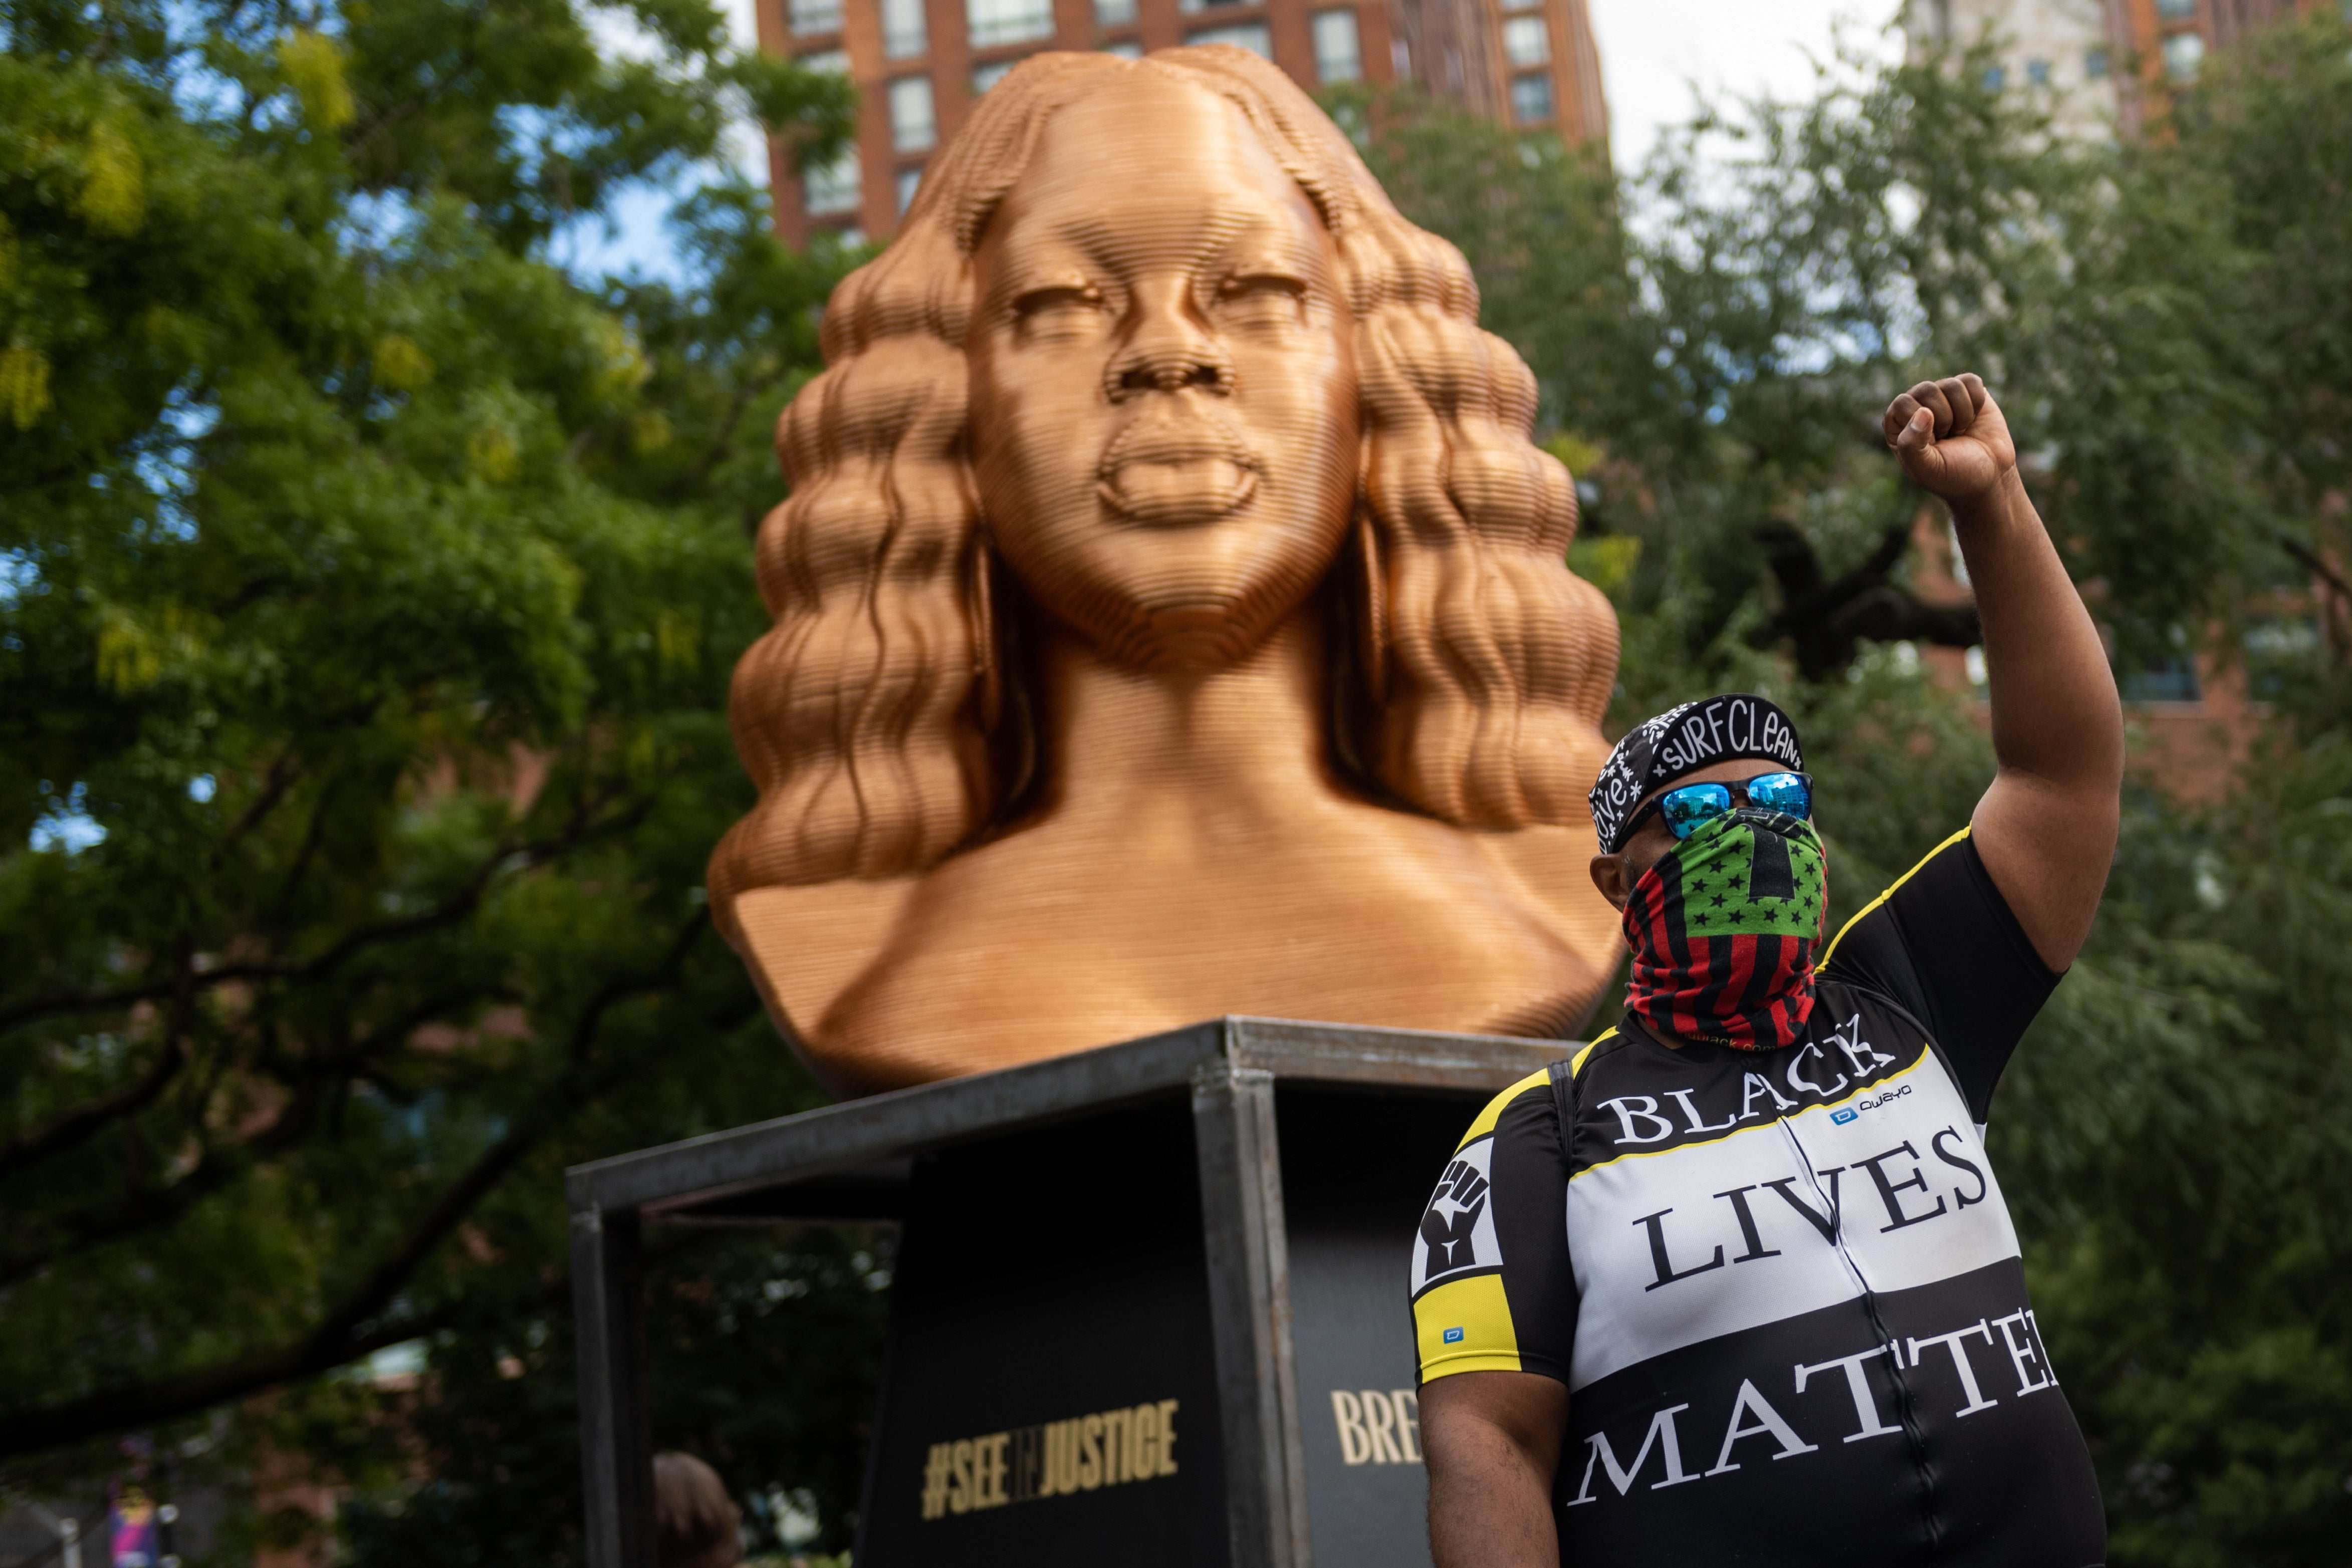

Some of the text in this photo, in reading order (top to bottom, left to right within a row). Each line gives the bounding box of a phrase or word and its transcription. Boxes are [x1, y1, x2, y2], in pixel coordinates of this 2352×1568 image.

[1596, 1013, 1896, 1145] BLACK
[1632, 1125, 1987, 1293] LIVES
[1568, 1307, 2059, 1506] MATTE
